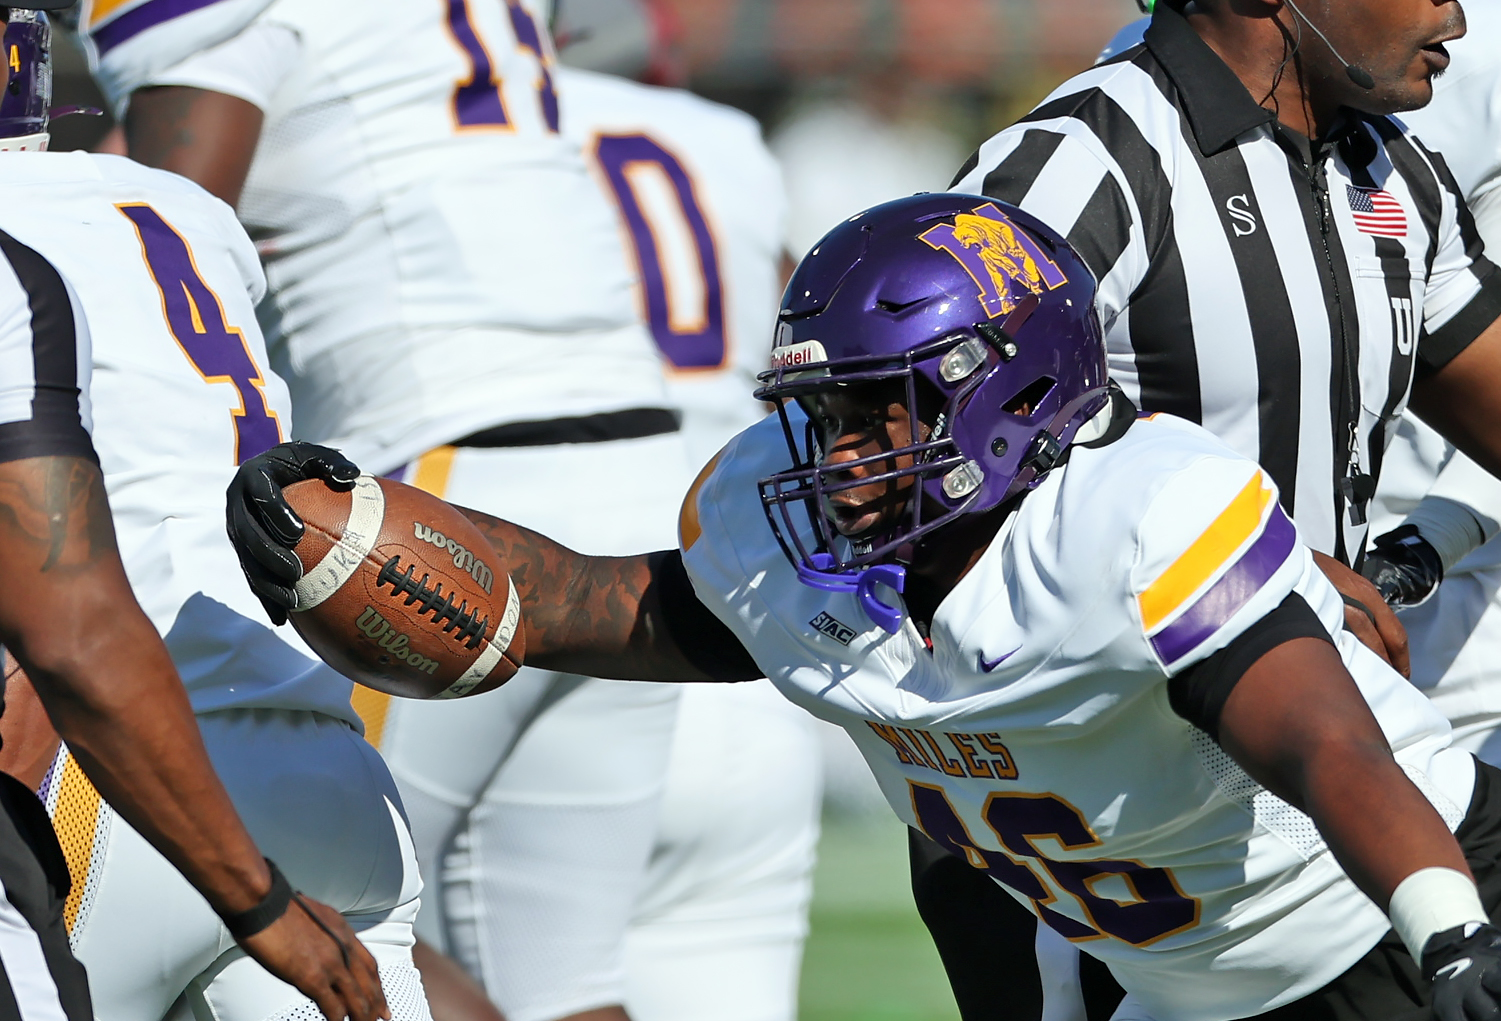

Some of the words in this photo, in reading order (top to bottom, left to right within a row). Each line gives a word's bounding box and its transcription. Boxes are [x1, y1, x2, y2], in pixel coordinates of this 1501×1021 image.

[9, 44, 21, 73] 4
[1226, 193, 1257, 237] S
[112, 201, 284, 467] 4
[1391, 297, 1413, 356] U
[413, 520, 495, 596] Wilson
[356, 605, 441, 677] Wilson
[864, 720, 1019, 780] MILES
[904, 777, 1203, 948] 46
